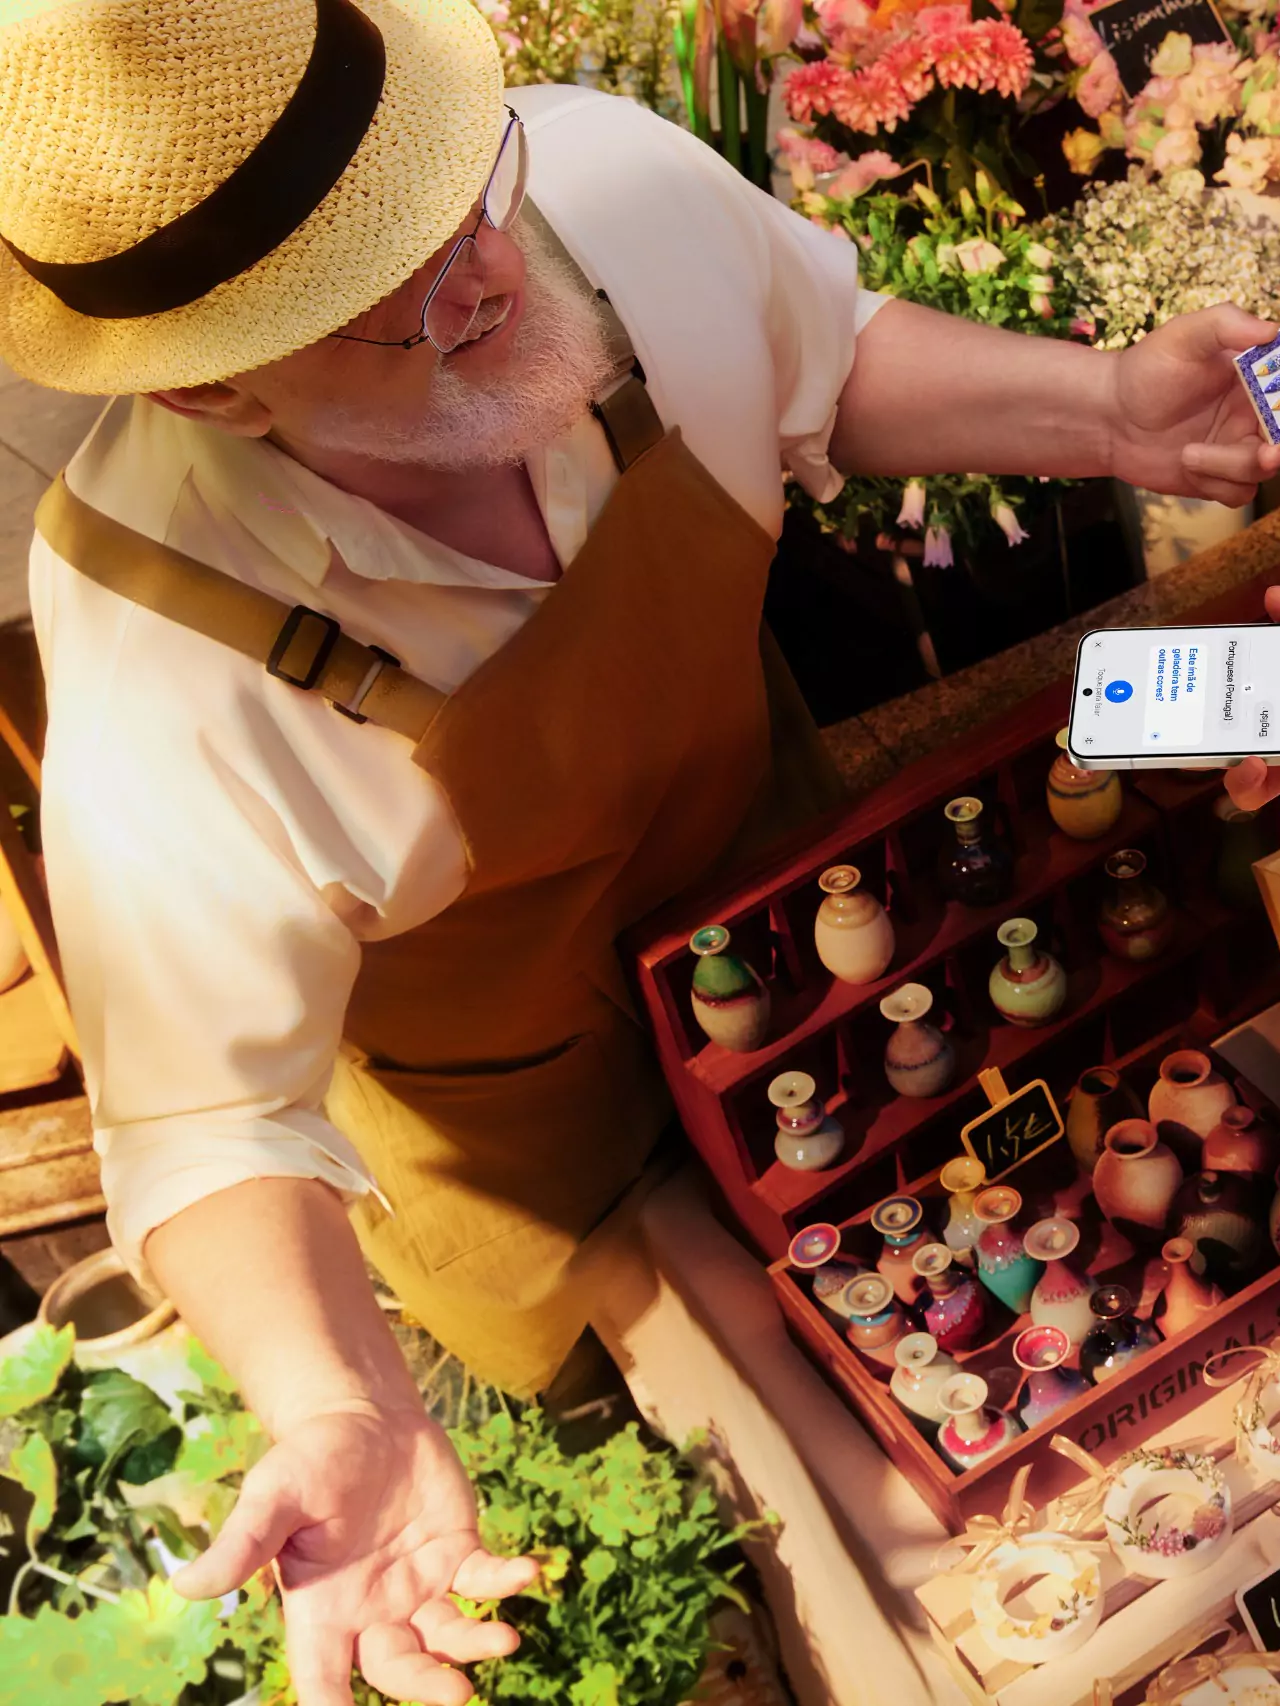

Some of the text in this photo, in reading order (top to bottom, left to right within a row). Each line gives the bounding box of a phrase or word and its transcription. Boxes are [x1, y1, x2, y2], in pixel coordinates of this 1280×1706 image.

[1155, 648, 1166, 702] outras cores?
[1170, 648, 1182, 702] geladeira tem
[1188, 648, 1198, 665] Este
[1186, 682, 1196, 693] de
[1223, 640, 1237, 721] Portuguese (Portugal)
[1258, 710, 1270, 738] English
